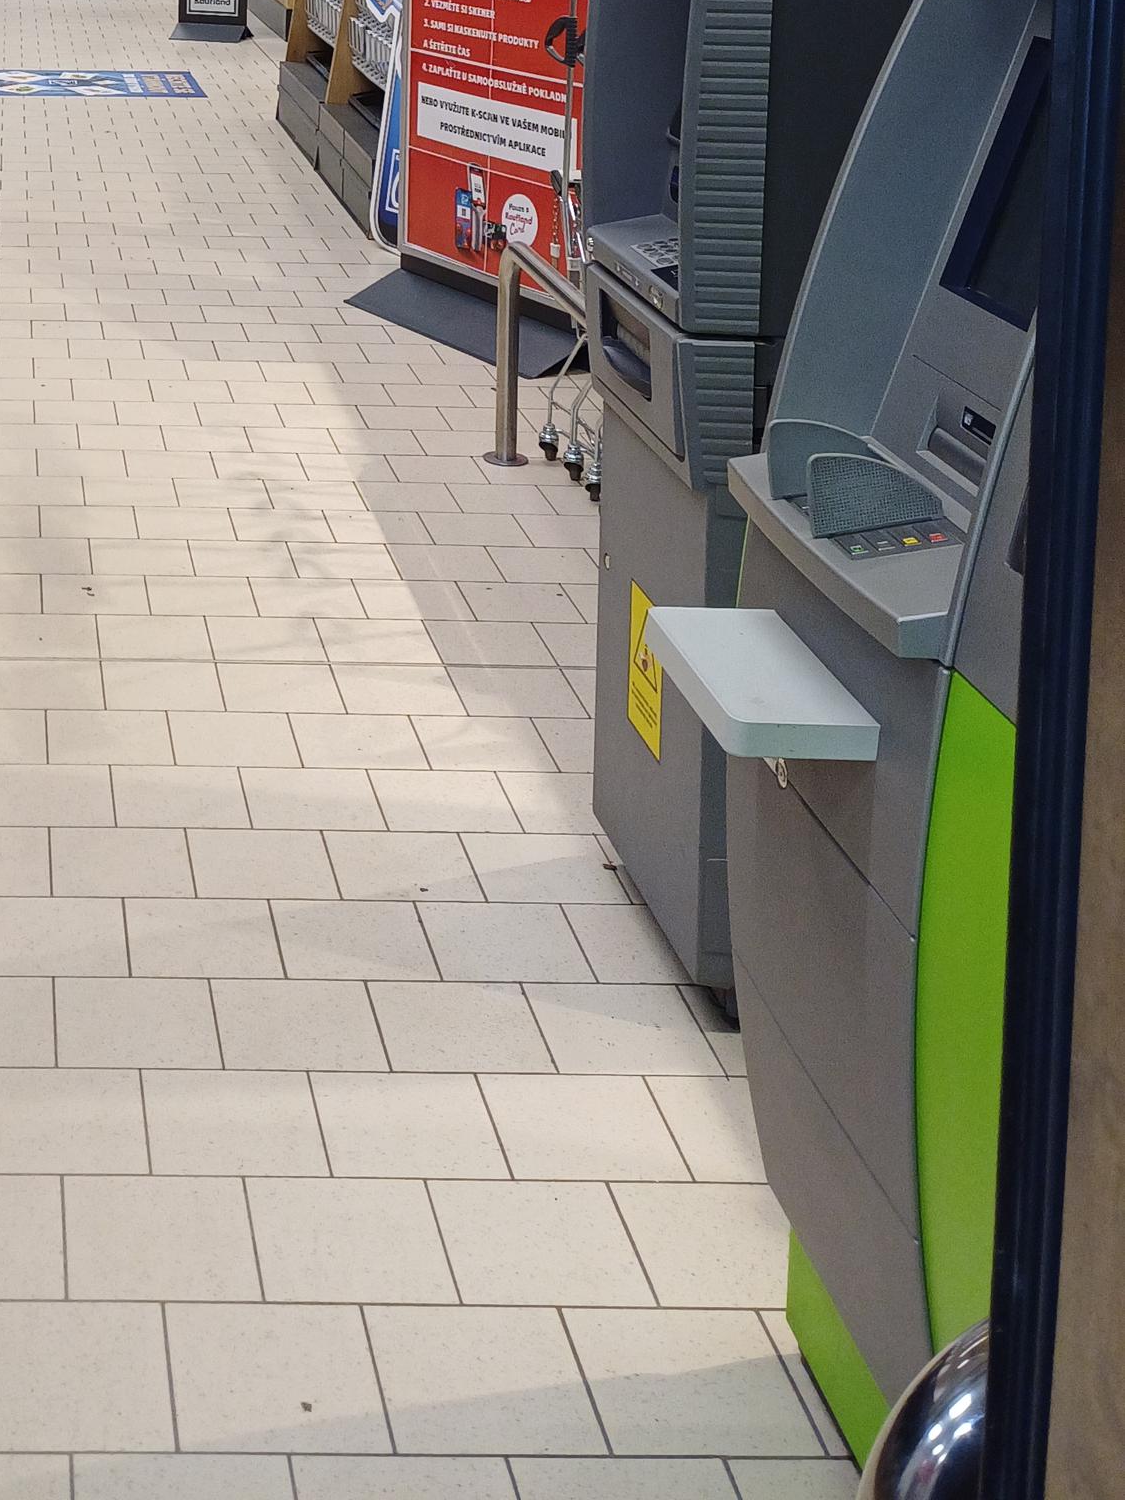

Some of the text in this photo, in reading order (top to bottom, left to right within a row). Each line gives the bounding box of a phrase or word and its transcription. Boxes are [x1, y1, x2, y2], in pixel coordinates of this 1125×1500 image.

[460, 4, 468, 13] SI
[422, 39, 428, 48] A
[457, 44, 471, 57] ČAS
[498, 32, 540, 49] PRODUKTY
[462, 71, 467, 80] U
[421, 95, 438, 107] NEBO
[471, 108, 498, 123] K-SCAN
[499, 115, 510, 126] VE
[511, 118, 539, 133] VAŠEM
[440, 122, 546, 157] PROSTŘEDNICTVÍM APLIKACE
